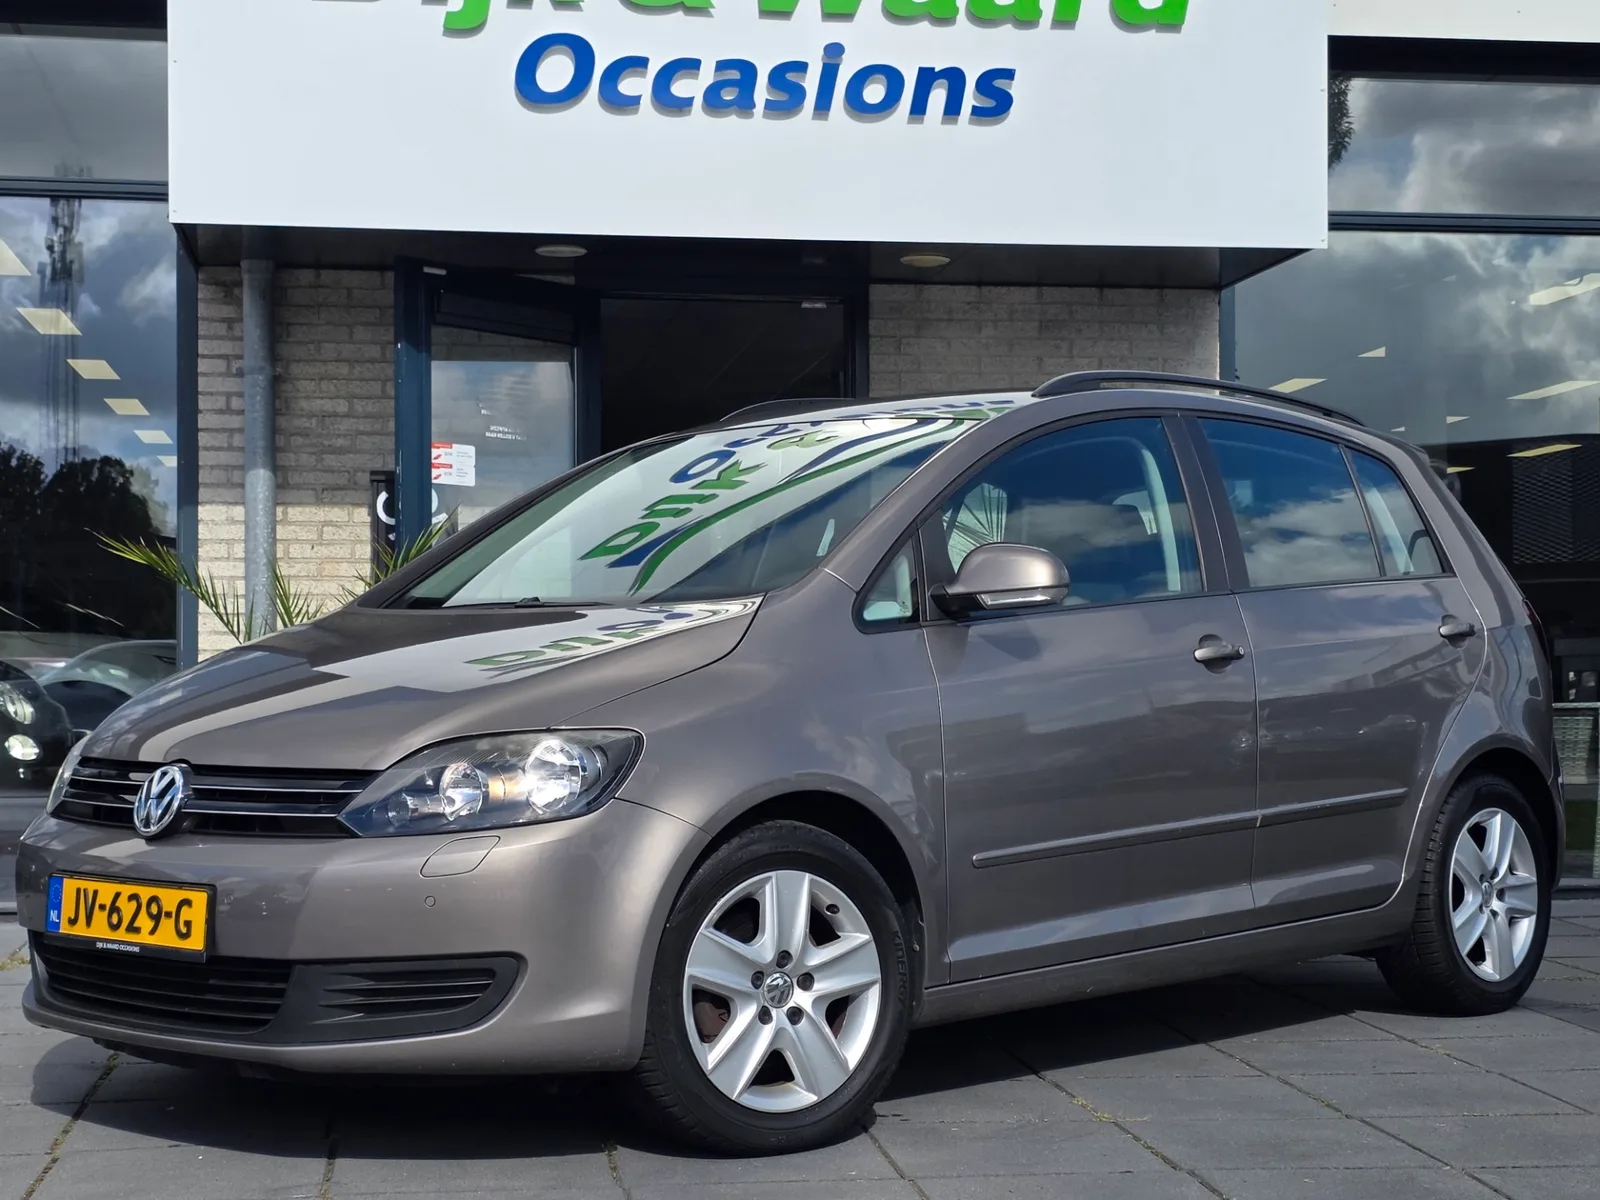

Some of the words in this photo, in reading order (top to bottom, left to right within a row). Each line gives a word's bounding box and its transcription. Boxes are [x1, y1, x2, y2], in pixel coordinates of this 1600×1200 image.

[514, 33, 1016, 119] Occasions
[50, 908, 60, 923] NL
[67, 886, 194, 942] JV-629-G
